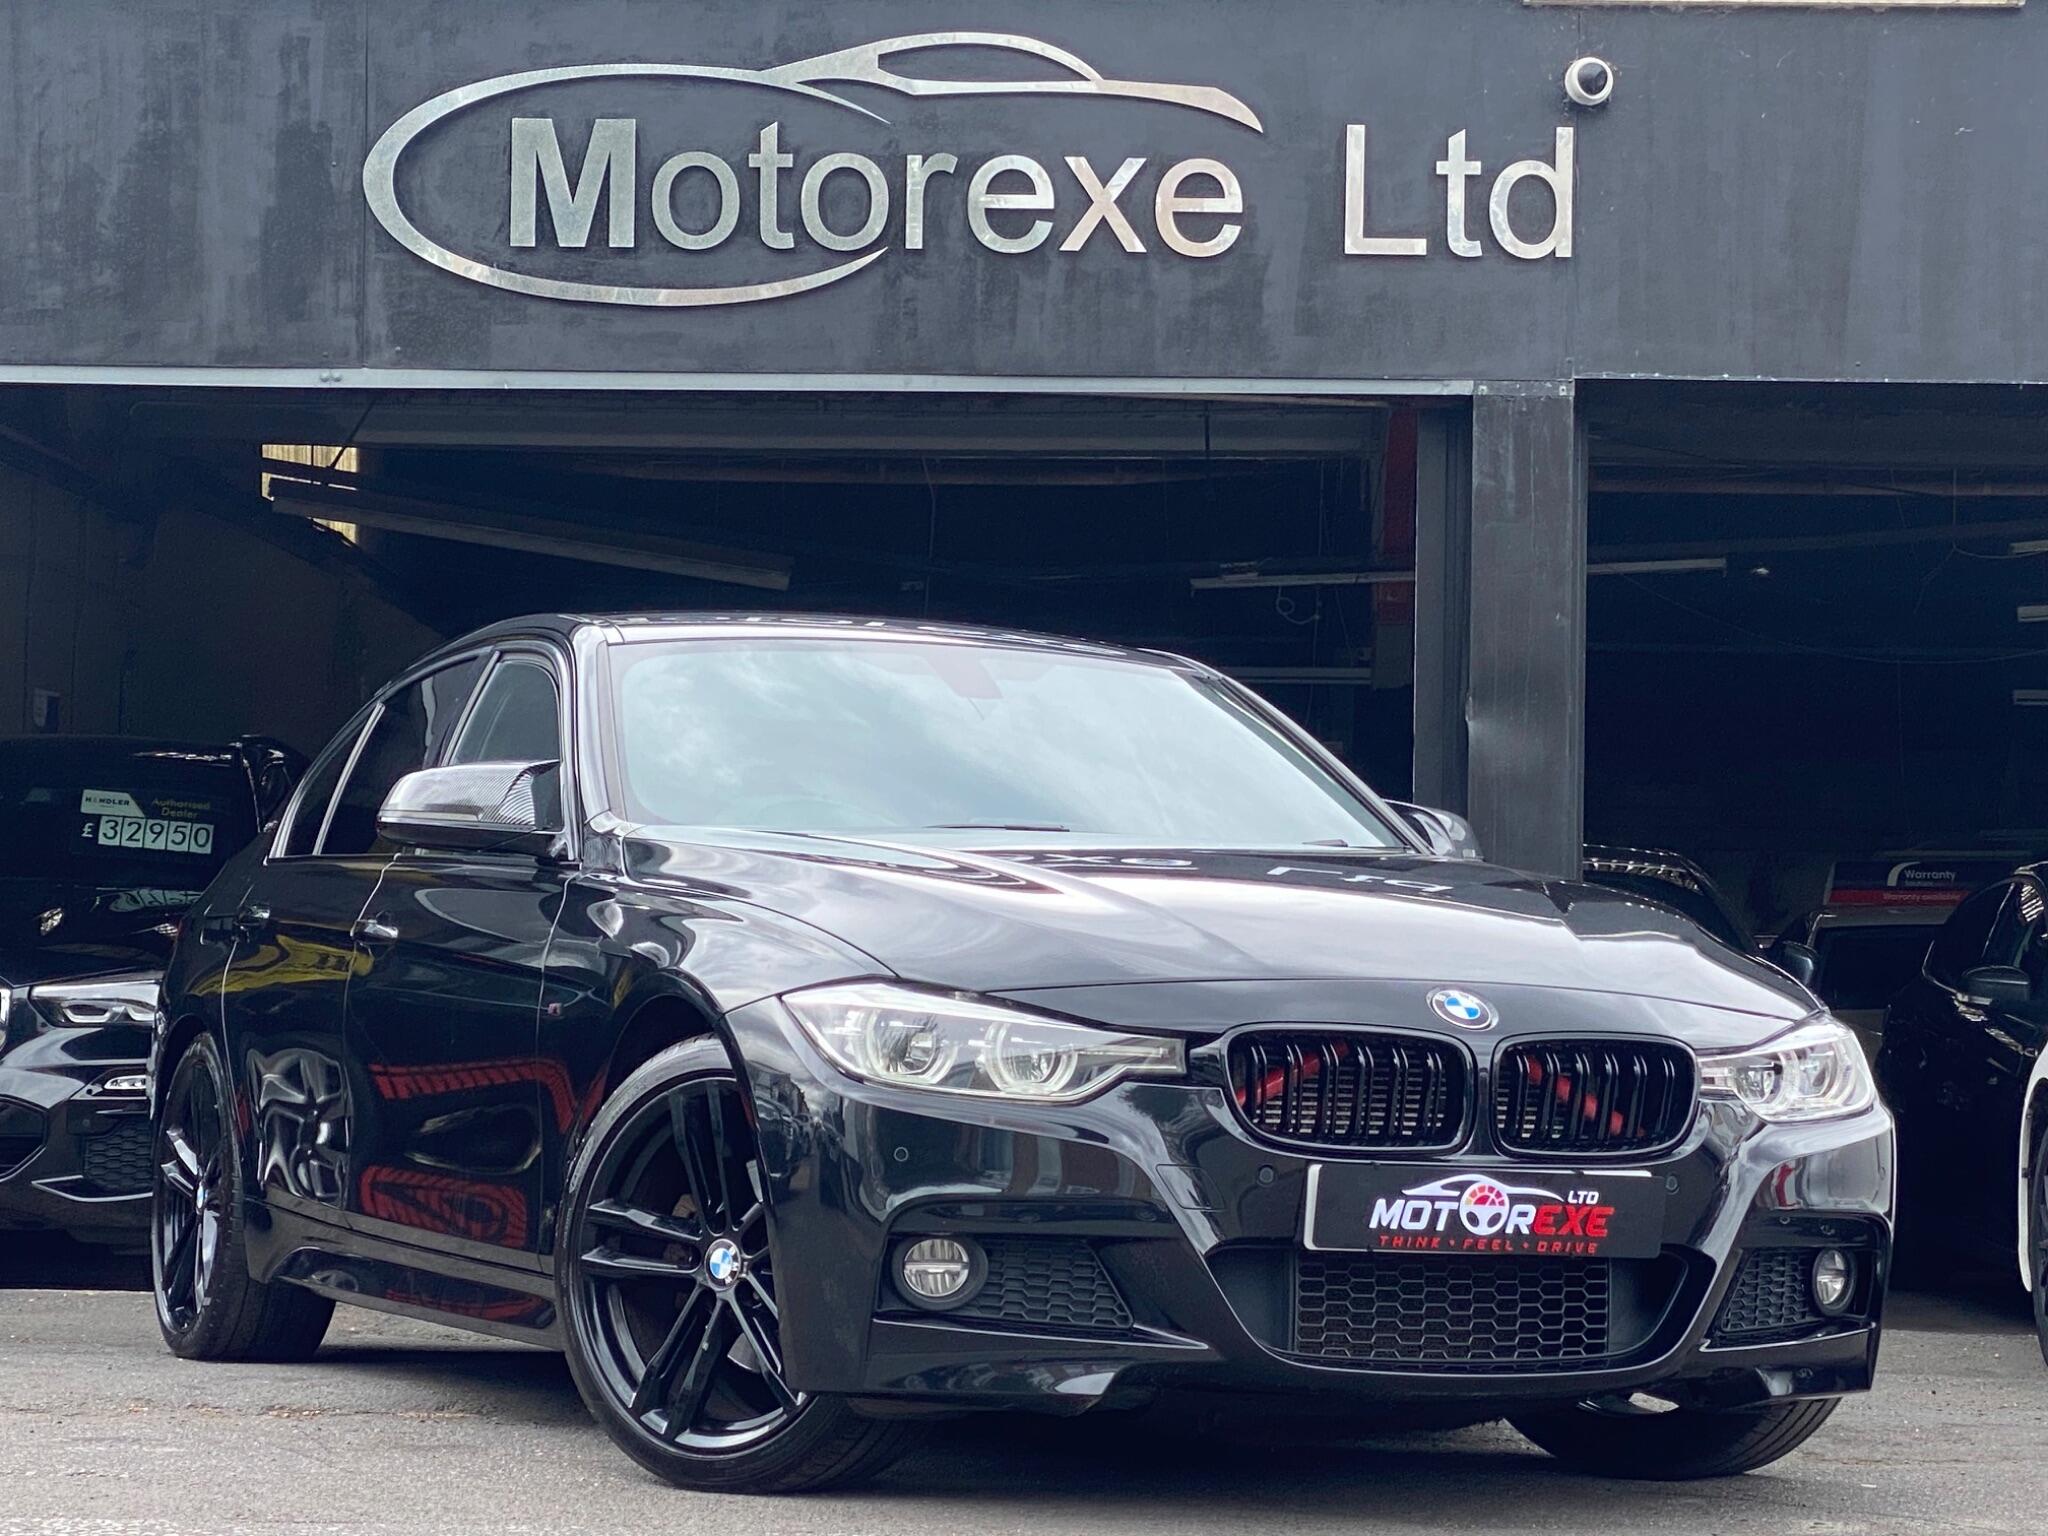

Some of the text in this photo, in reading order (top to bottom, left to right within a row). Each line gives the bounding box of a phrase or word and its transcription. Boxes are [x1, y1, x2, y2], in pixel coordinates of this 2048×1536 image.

[508, 116, 1575, 261] Motorexe Ltd
[1904, 869, 1956, 882] Warranty
[1567, 1190, 1600, 1205] LTD
[1379, 1235, 1598, 1254] THINK FEEL DRIVE
